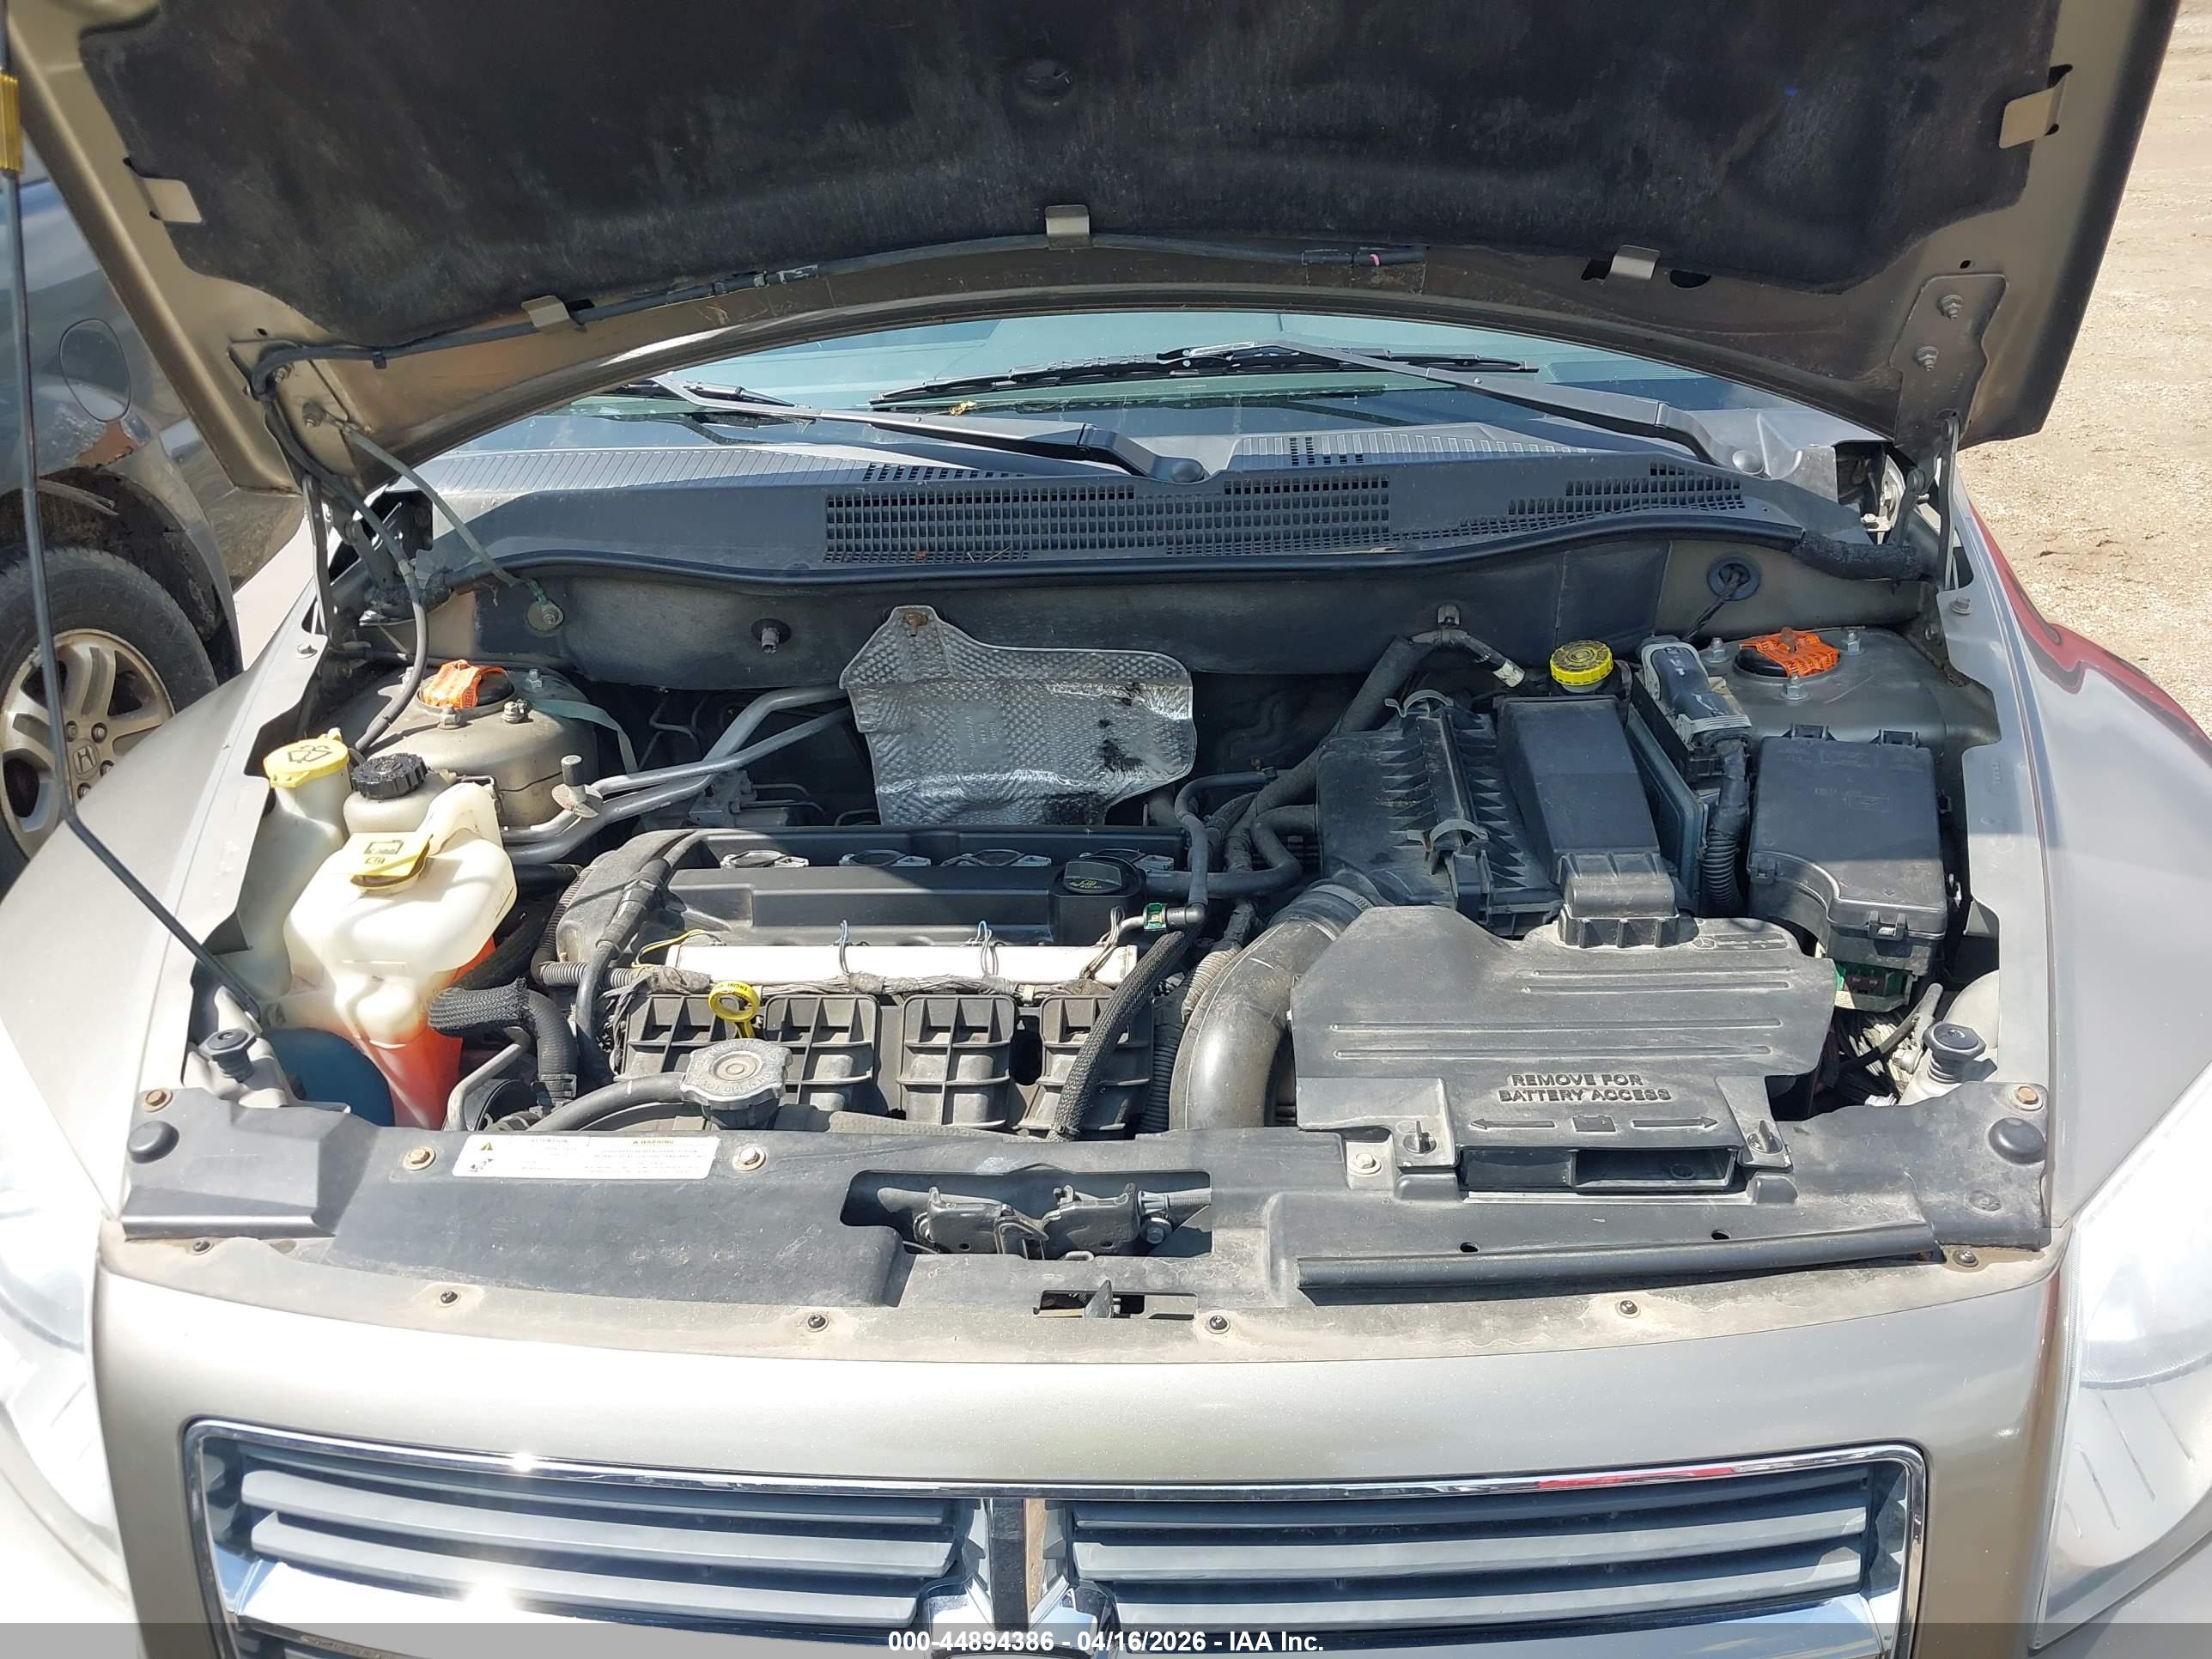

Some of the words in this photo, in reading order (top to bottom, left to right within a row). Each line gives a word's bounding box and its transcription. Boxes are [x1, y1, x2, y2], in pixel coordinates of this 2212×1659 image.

[1510, 1073, 1596, 1086] REMOVE
[1601, 1073, 1644, 1085] FOR
[1498, 1089, 1584, 1102] BATTERY
[1591, 1088, 1672, 1101] ACCESS
